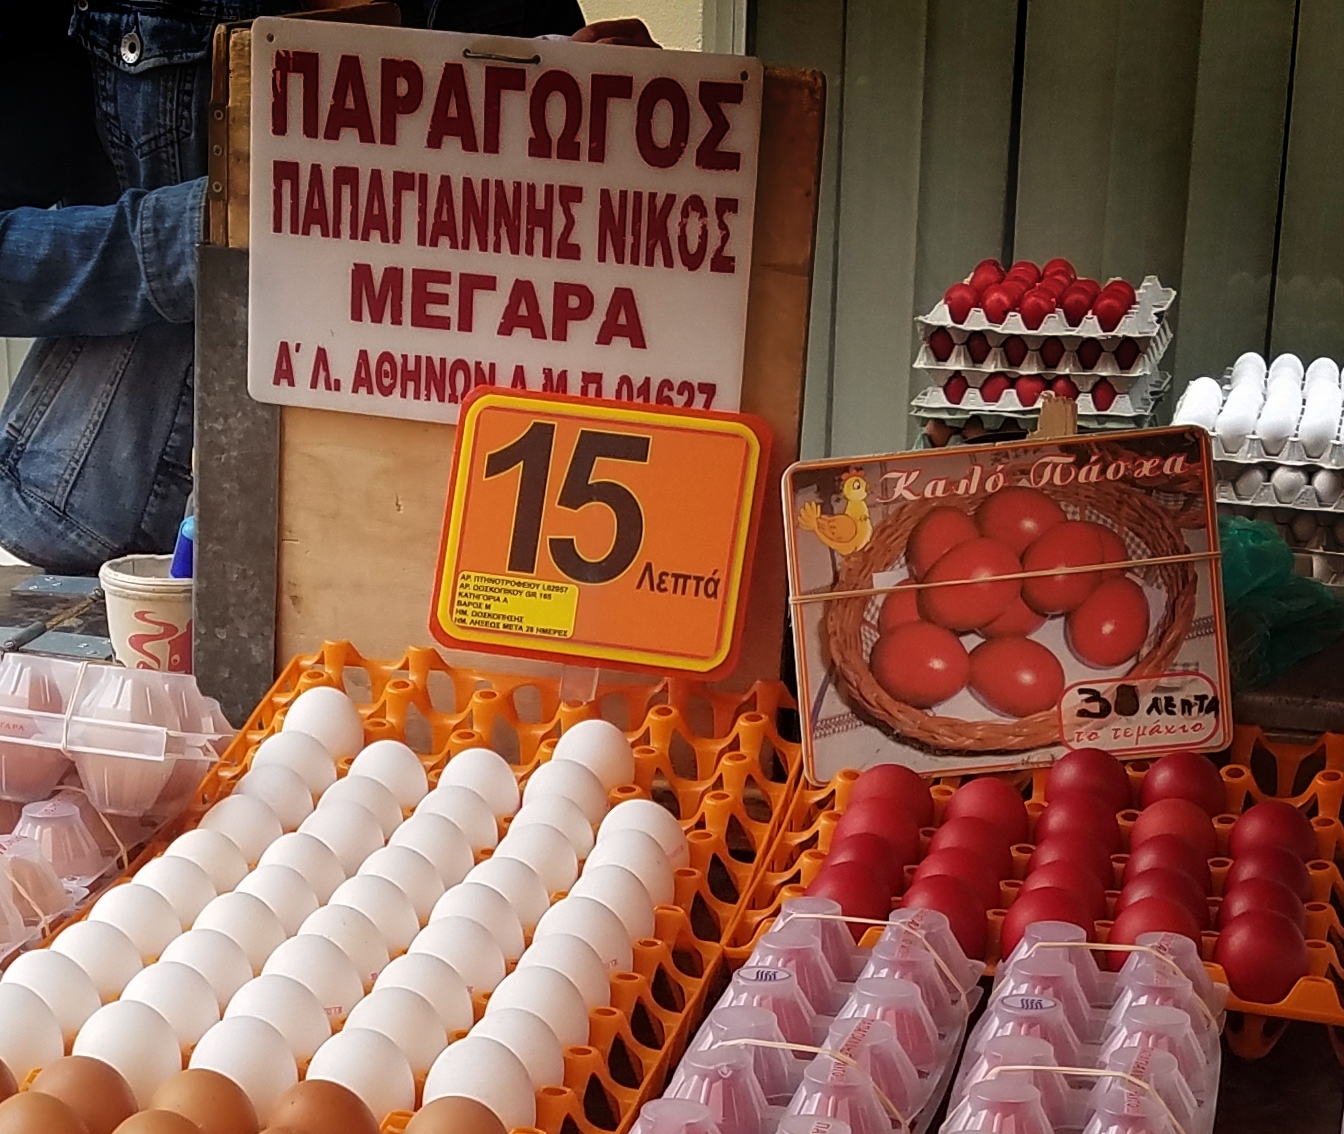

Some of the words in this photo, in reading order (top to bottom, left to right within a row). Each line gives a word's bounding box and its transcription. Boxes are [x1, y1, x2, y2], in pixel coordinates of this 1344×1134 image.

[271, 49, 744, 172] ΠΑΡΑΓΩΓΟΣ
[272, 160, 583, 261] ΠΑΠΑΓΙΑΝΝΗΣ
[598, 188, 739, 274] ΝΙΚΟΣ
[350, 263, 647, 349] ΜΕΓΑΡΑ
[352, 349, 496, 403] ΑΘΗΝΩΝ
[483, 420, 652, 586] 15
[876, 465, 1005, 502] Καλό
[1030, 451, 1190, 489] Πάσχα
[635, 562, 720, 600] Λεπτά
[1075, 731, 1100, 743] το
[1112, 719, 1205, 745] τεμάχιο
